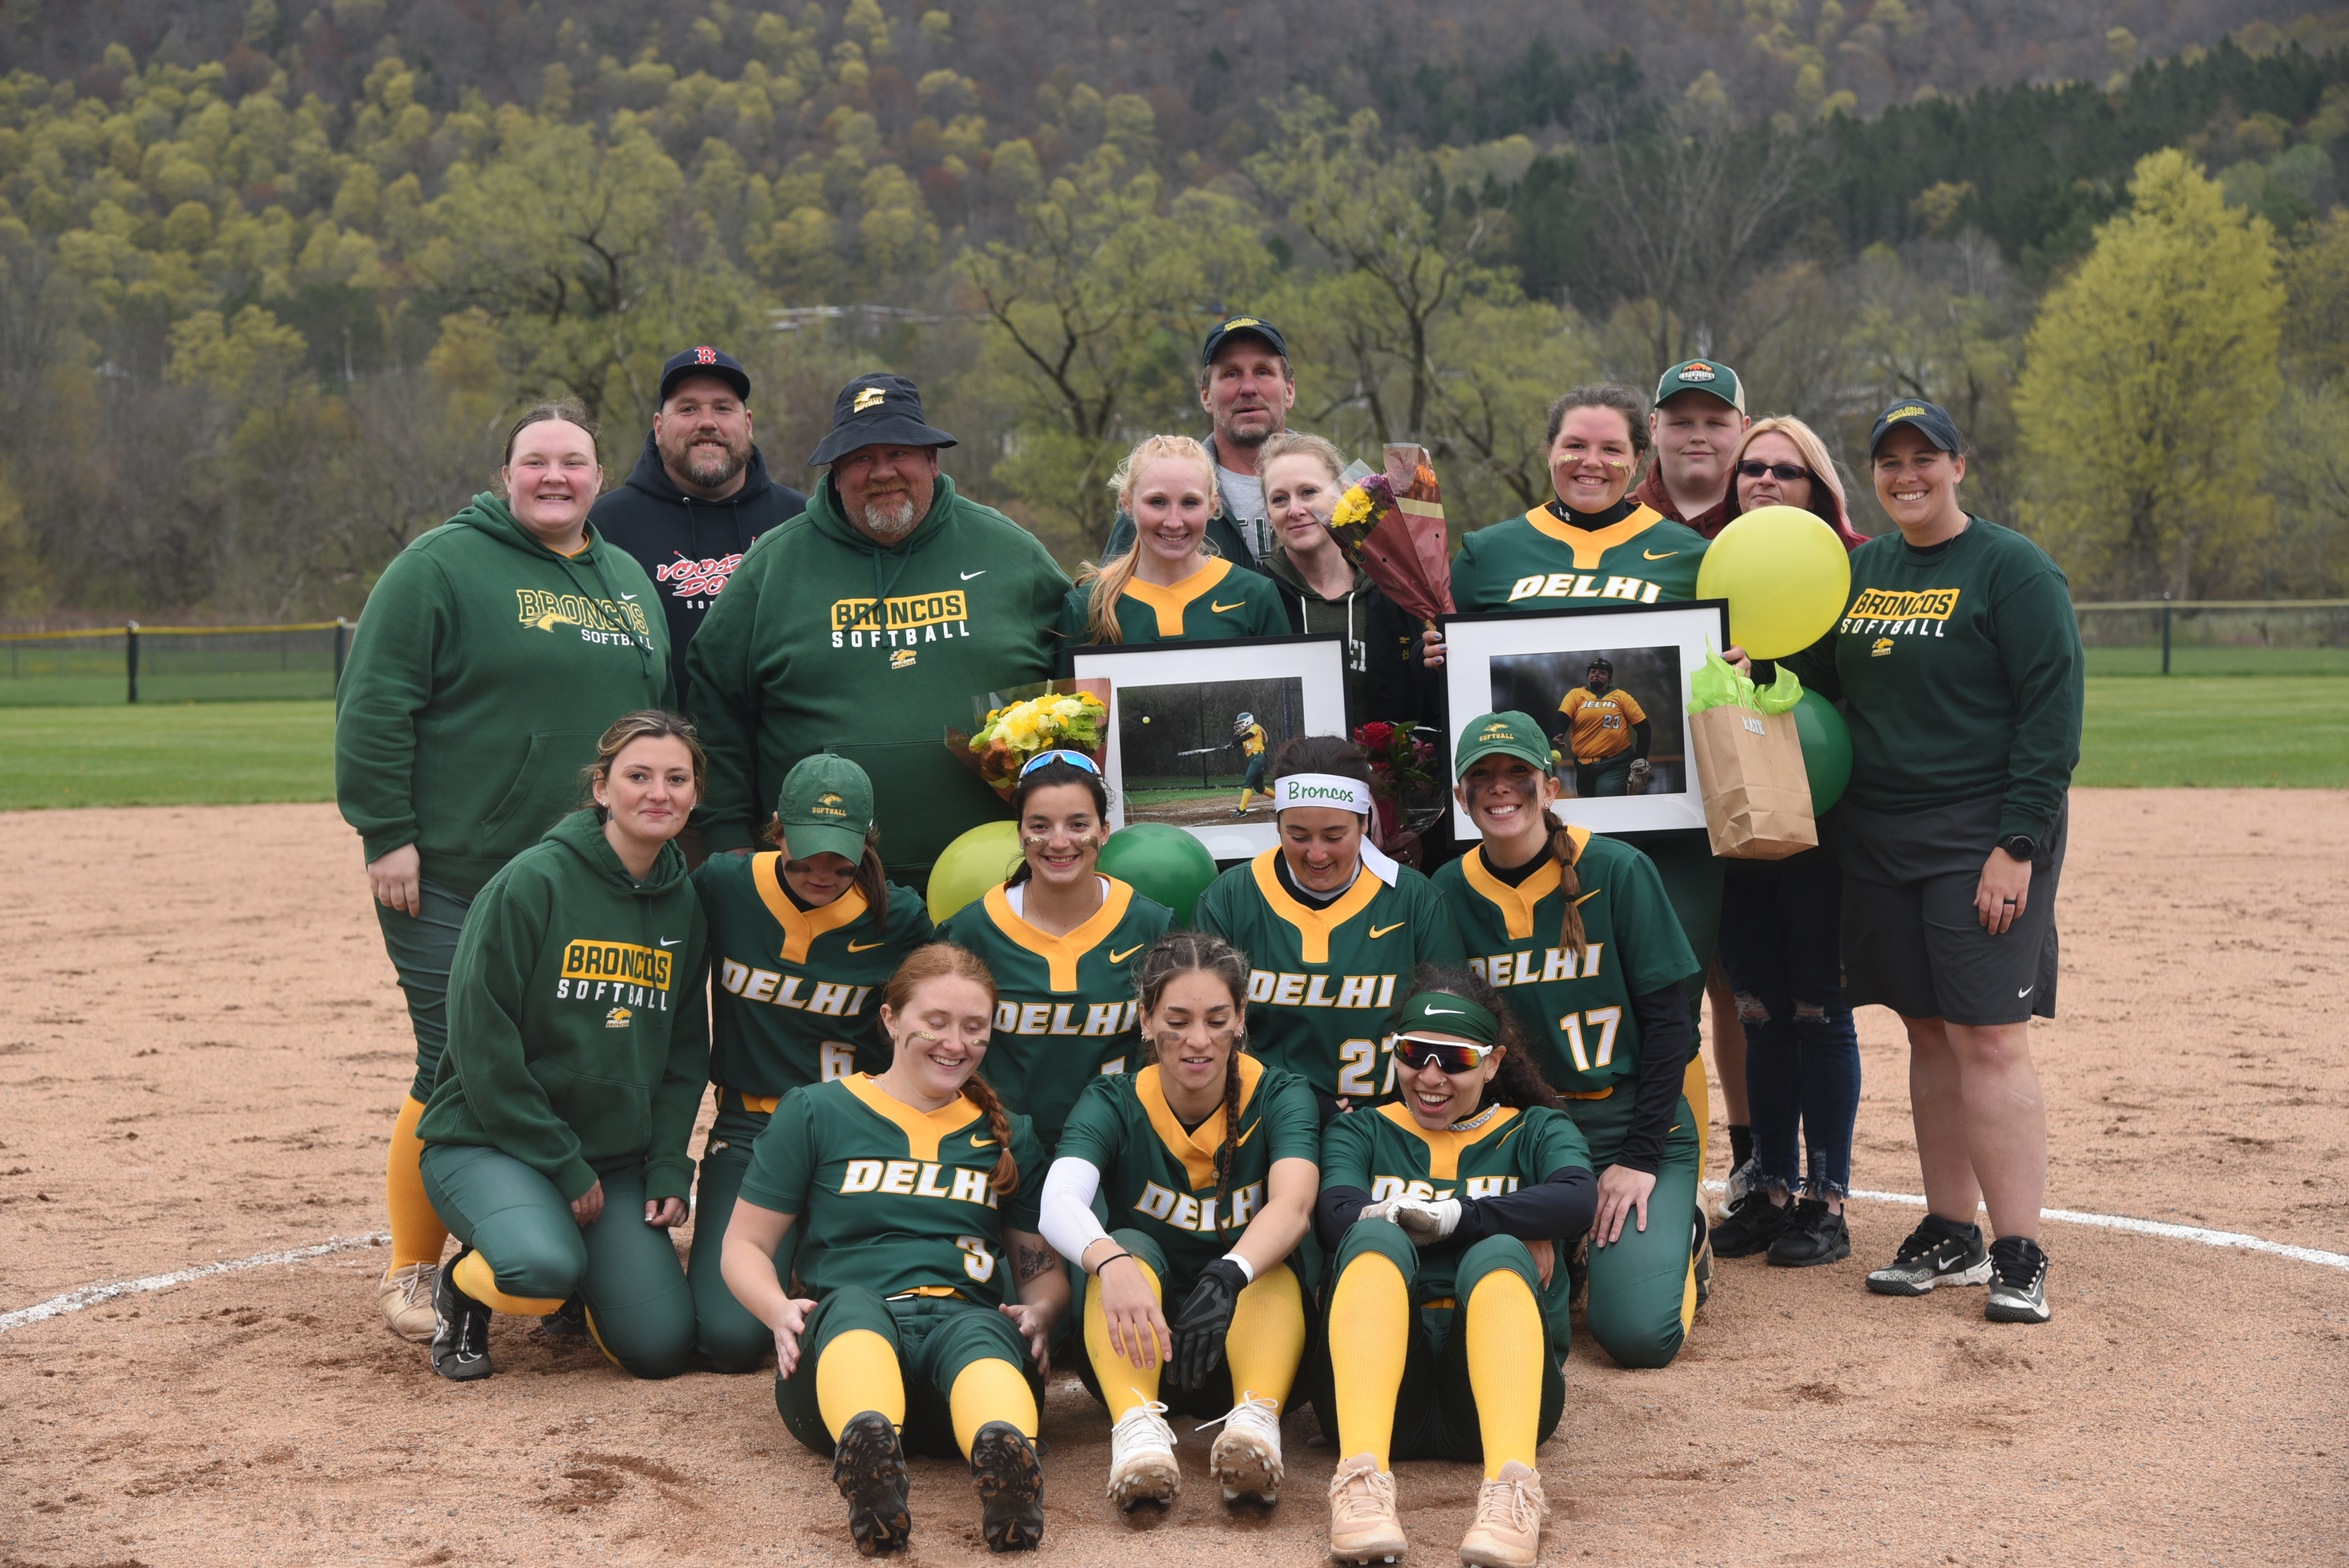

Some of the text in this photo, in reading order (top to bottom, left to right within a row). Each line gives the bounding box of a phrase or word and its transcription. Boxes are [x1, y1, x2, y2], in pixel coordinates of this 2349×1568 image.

[656, 553, 743, 581] VOOD
[1507, 573, 1663, 604] DELHI
[1853, 593, 1953, 616] BRONCOS
[516, 589, 649, 635] BRONCOS
[837, 595, 962, 625] BRONCOS
[832, 620, 970, 648] SOFTBALL
[1840, 618, 1945, 637] SOFTBALL
[1479, 733, 1515, 742] SOFTBALL
[1602, 714, 1620, 729] 23
[1287, 781, 1354, 802] Broncos
[812, 806, 847, 816] SOFTBALL
[566, 945, 669, 984] BRONCOS
[1467, 943, 1605, 988] DELHI
[556, 979, 667, 1011] SOFTBALL
[721, 956, 875, 1017] DELHI
[1249, 969, 1398, 1009] DELHI
[992, 1000, 1140, 1036] DELHI
[1560, 1006, 1622, 1072] 17
[820, 1040, 857, 1083] 6
[1133, 1179, 1263, 1232] DELH
[956, 1235, 995, 1283] 3
